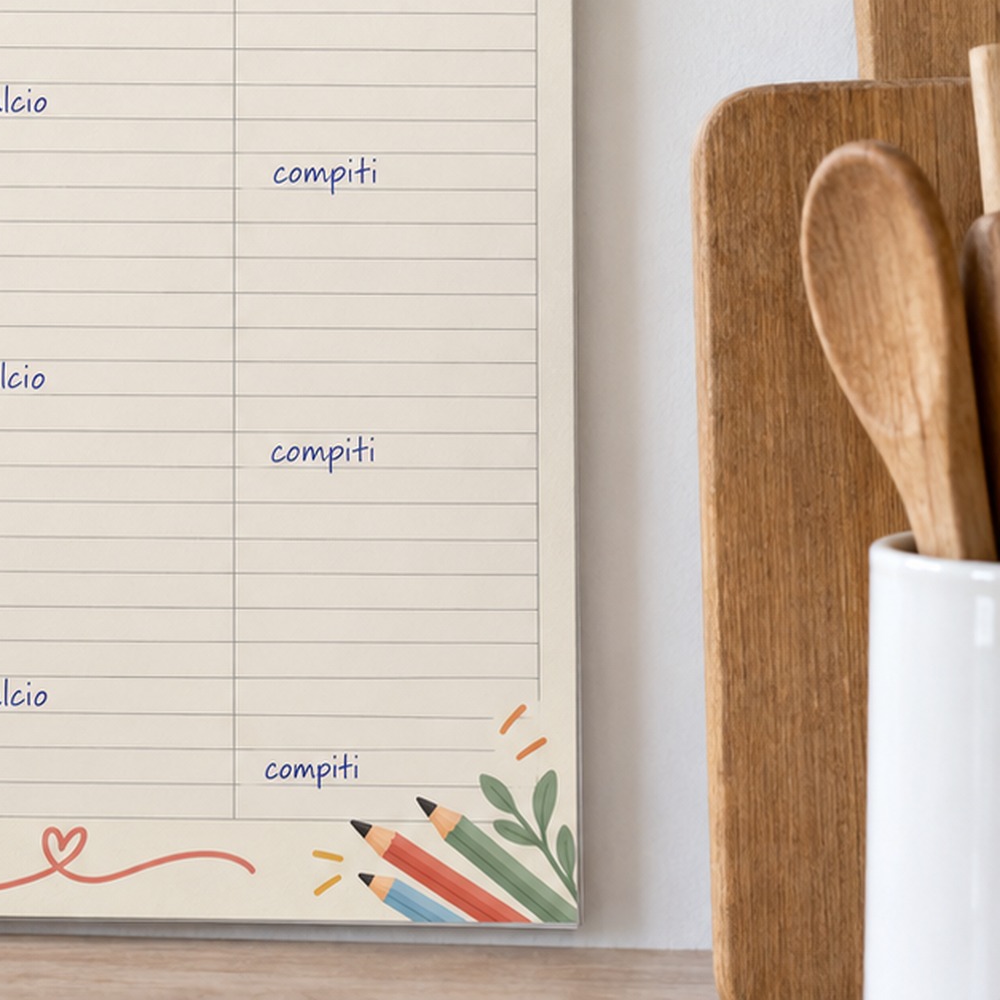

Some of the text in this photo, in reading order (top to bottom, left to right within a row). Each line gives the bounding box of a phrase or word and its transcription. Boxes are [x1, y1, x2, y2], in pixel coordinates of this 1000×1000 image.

[273, 158, 377, 194] compiti
[270, 437, 375, 473] compiti
[264, 754, 359, 789] compiti
